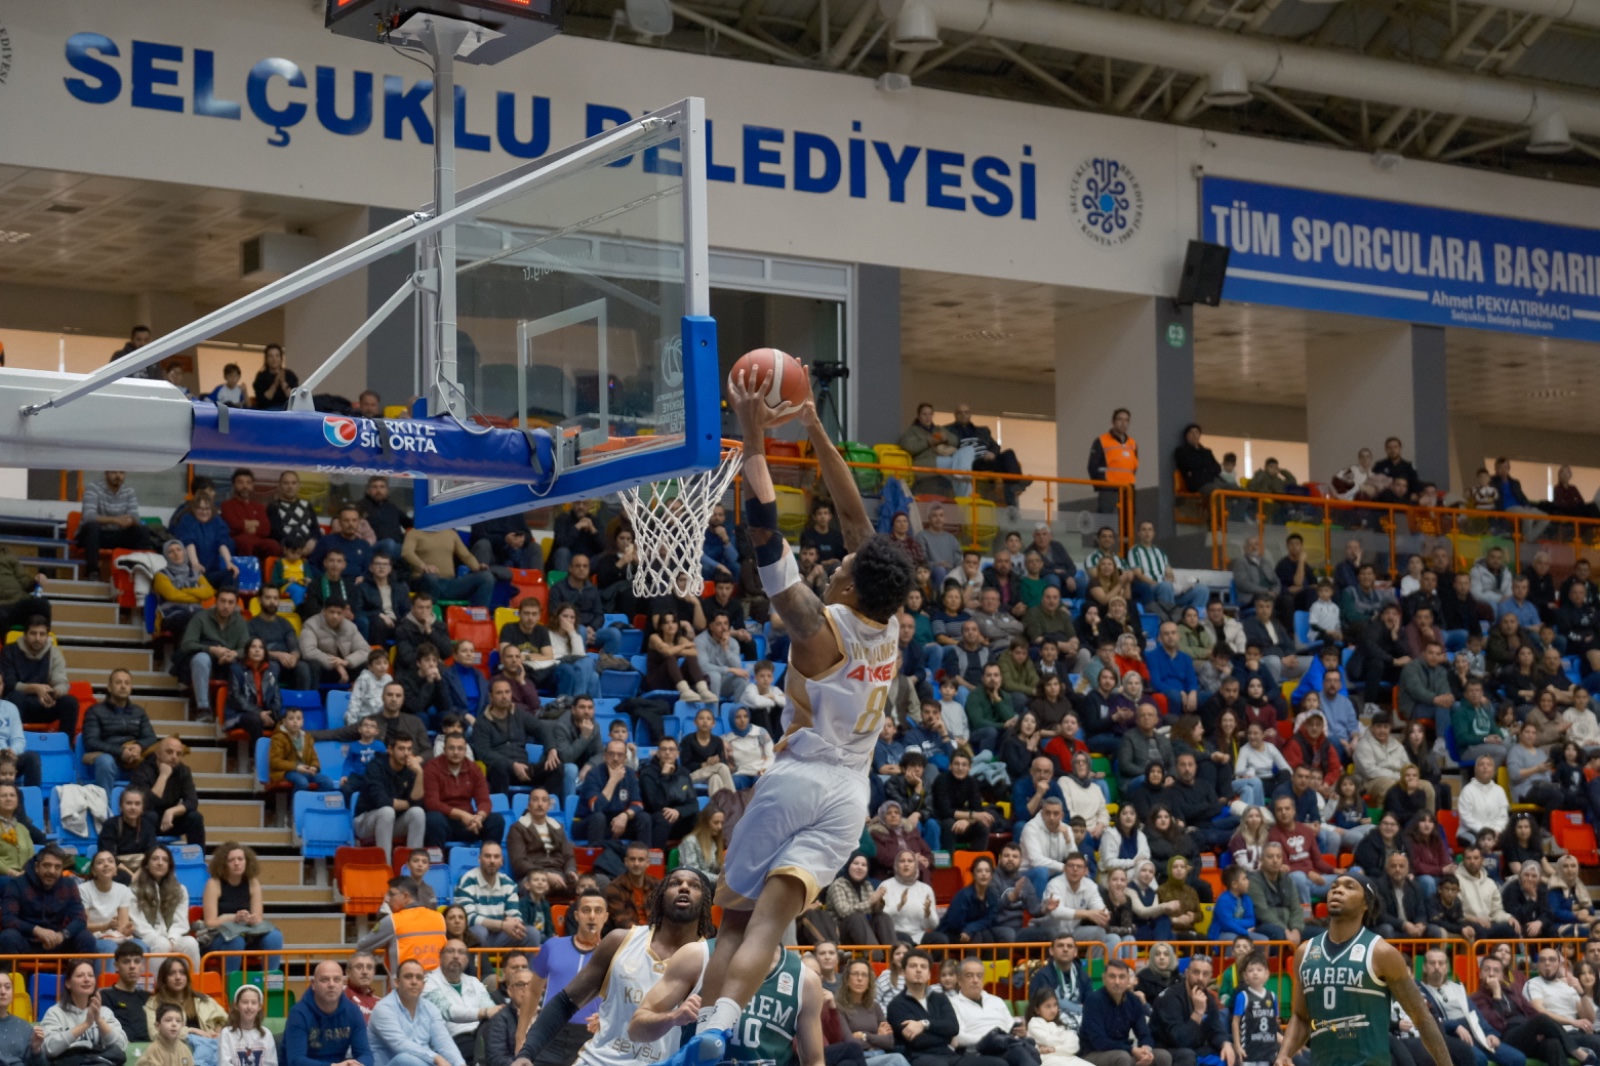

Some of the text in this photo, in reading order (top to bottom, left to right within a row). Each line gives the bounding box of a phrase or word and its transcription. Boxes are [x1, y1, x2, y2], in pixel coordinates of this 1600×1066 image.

[63, 31, 551, 159] SELÇUKLU
[1210, 199, 1280, 257] TÜM
[1291, 215, 1484, 284] SPORCULARA
[1432, 290, 1571, 320] Ahmet PEKYATIRMACI
[852, 685, 888, 735] 8
[1301, 966, 1364, 988] HAREM
[1323, 986, 1336, 1010] 0
[1259, 1016, 1269, 1032] 8
